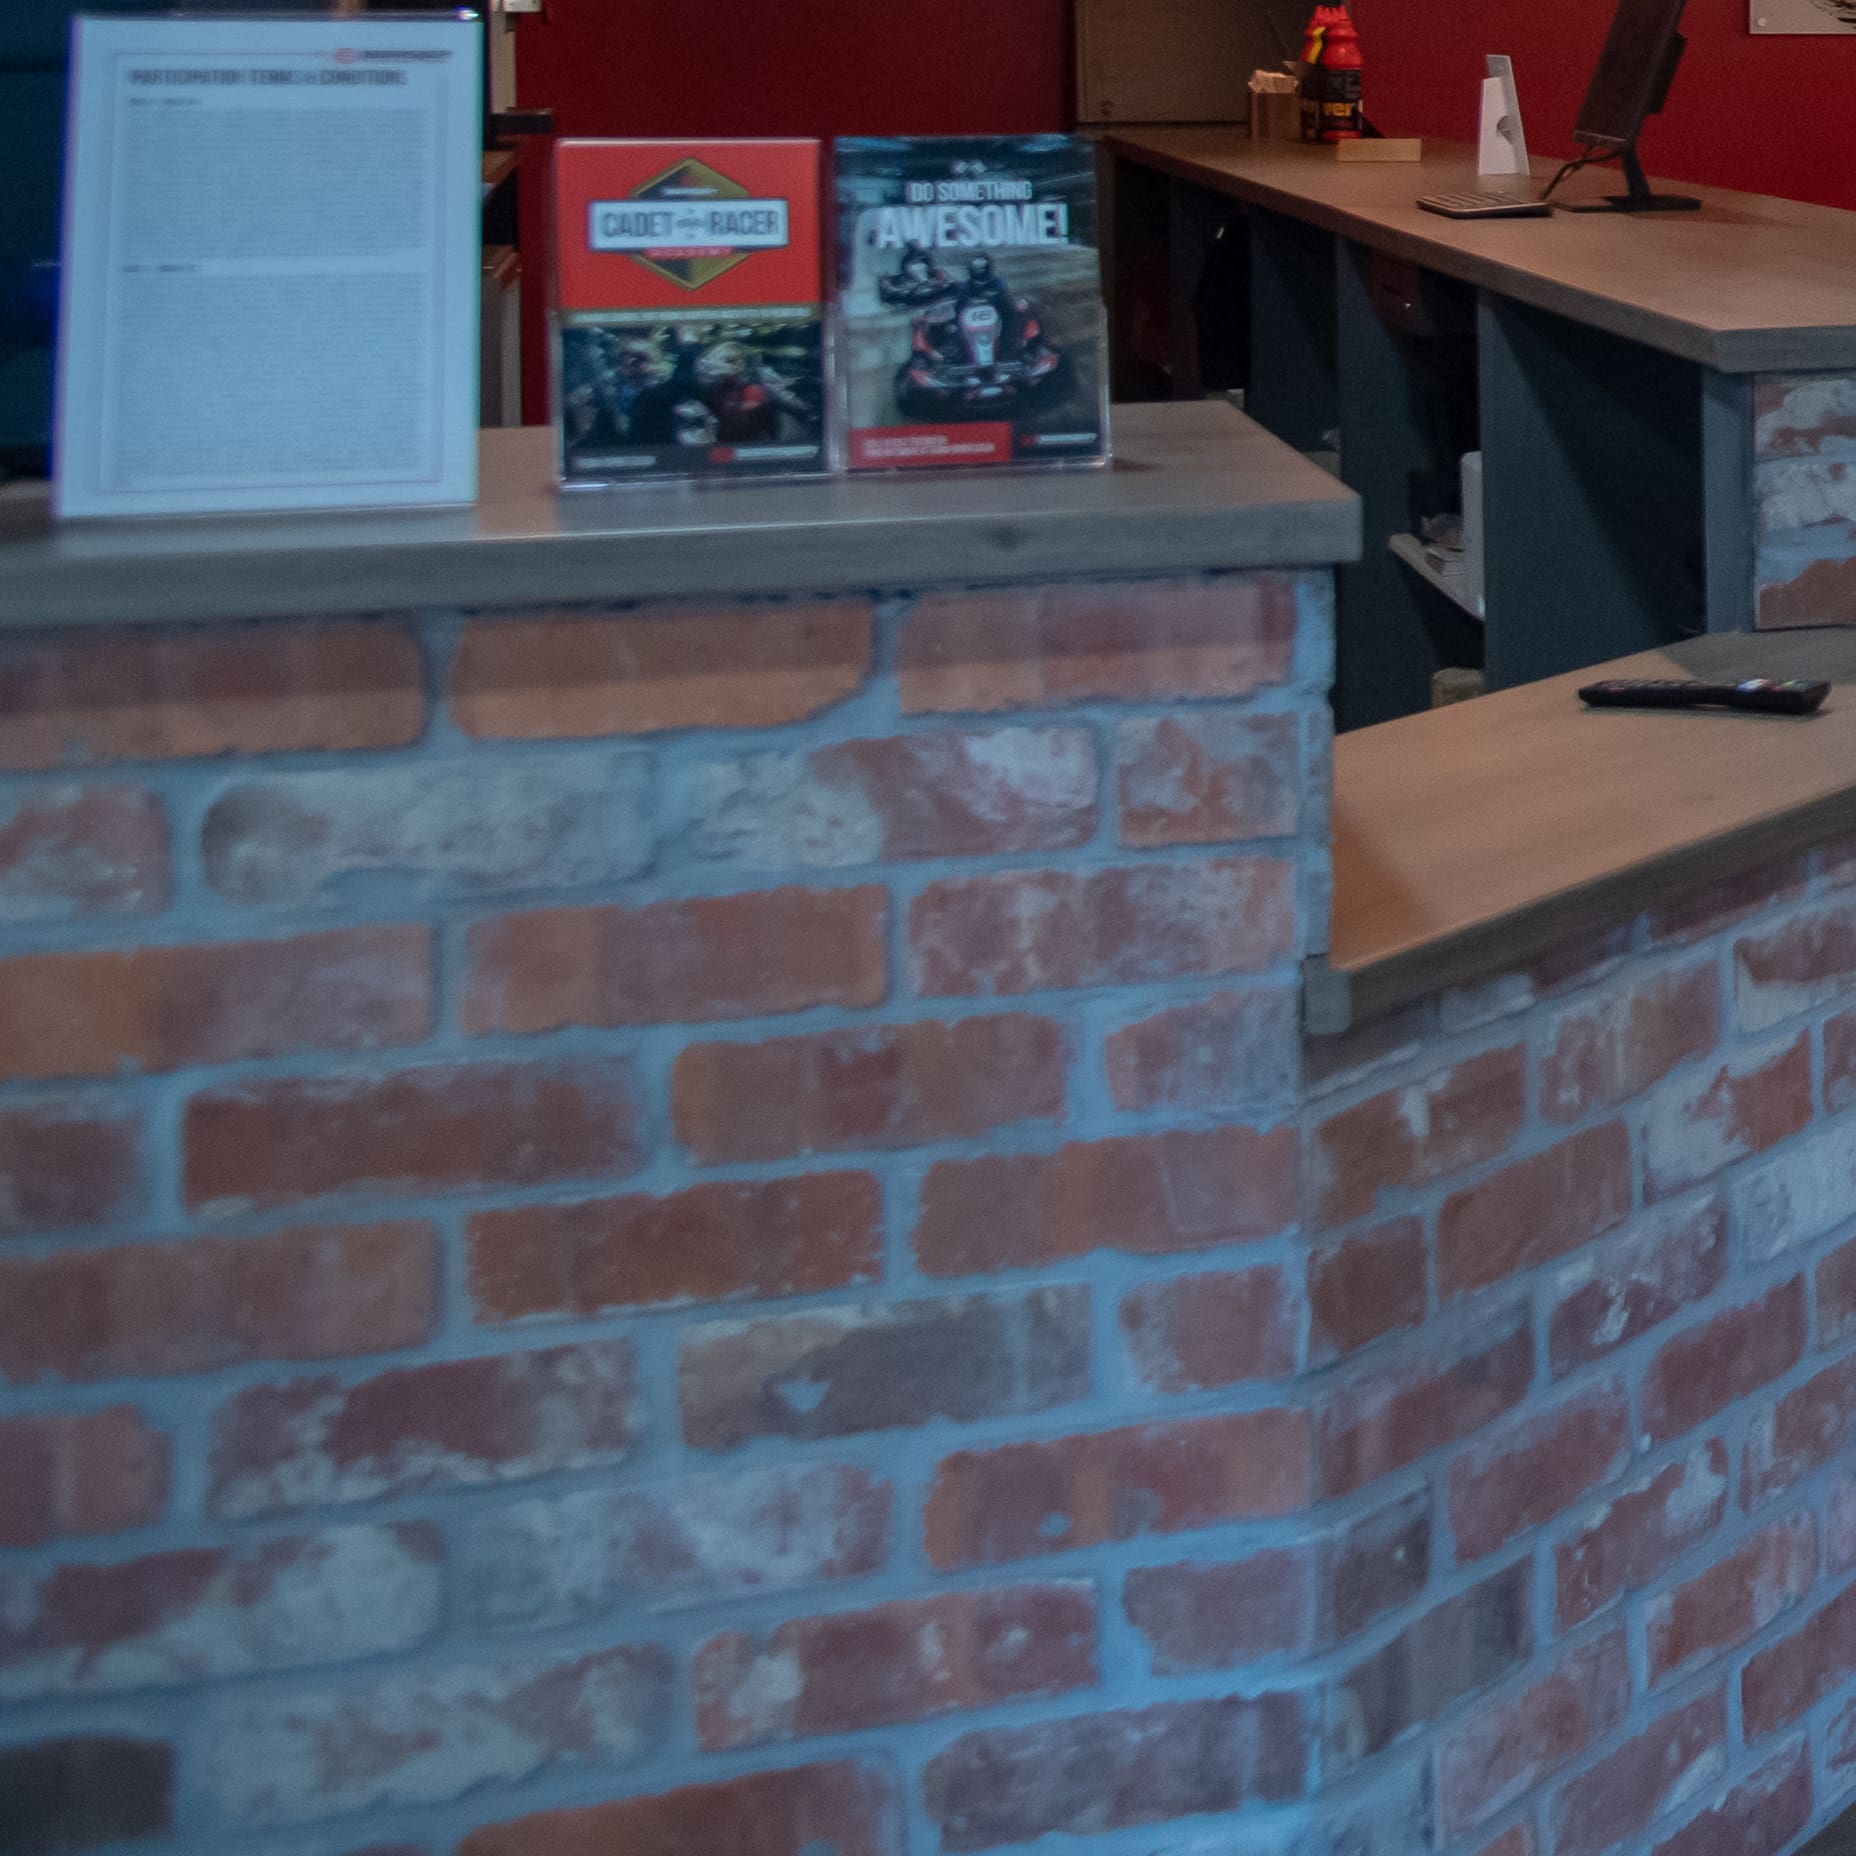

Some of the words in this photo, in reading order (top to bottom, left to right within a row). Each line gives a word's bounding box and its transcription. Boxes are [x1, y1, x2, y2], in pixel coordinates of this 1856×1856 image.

[911, 181, 934, 203] DO
[938, 179, 1033, 202] SOMETHING
[603, 211, 675, 238] CADET
[710, 210, 779, 236] RACER
[877, 203, 1070, 248] AWESOME!
